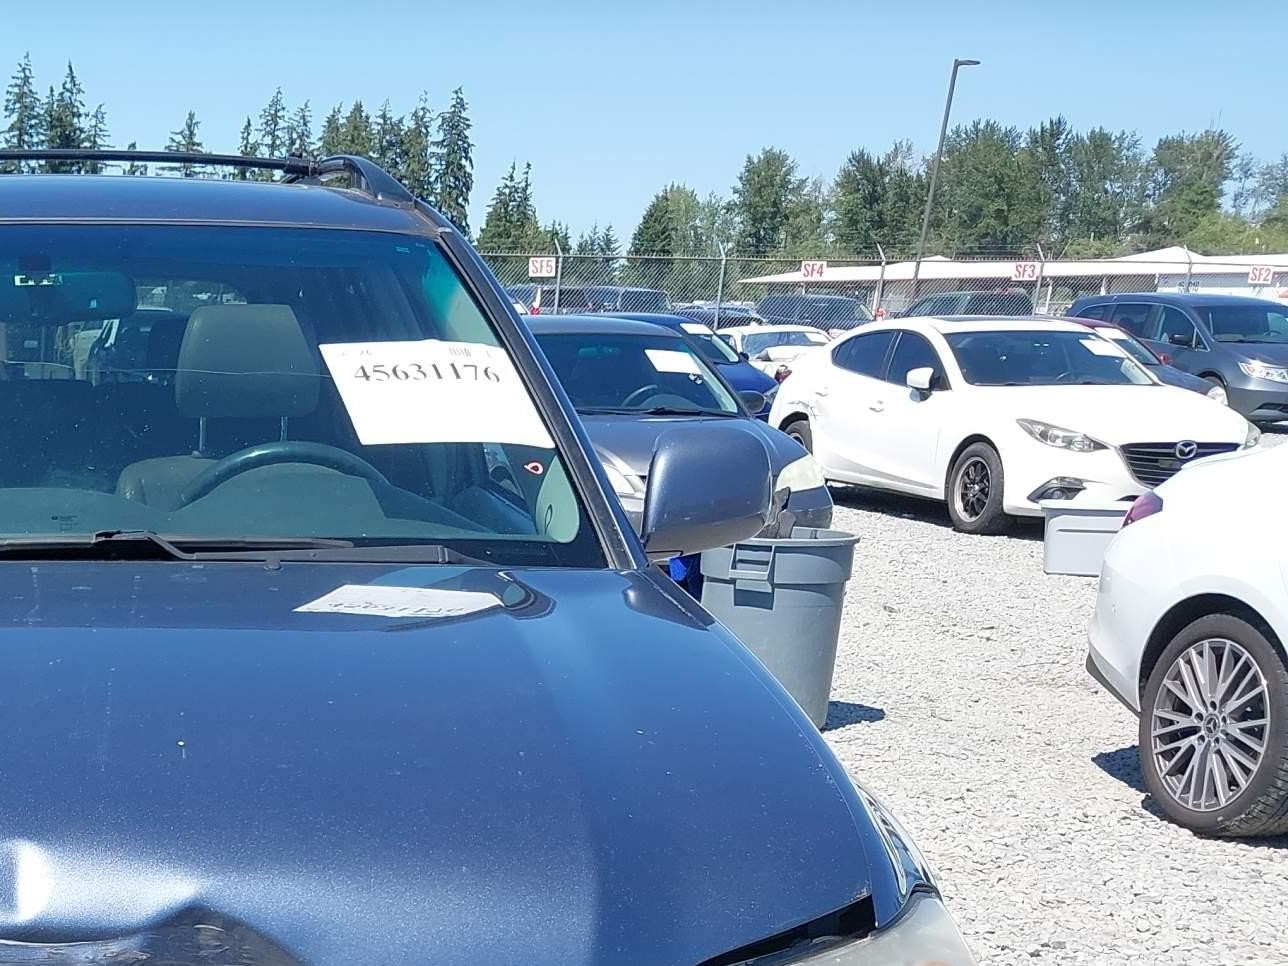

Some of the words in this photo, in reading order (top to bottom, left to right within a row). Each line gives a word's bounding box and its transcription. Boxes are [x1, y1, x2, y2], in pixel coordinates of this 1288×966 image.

[532, 259, 554, 274] SF5
[803, 263, 824, 278] SF4
[1015, 264, 1036, 279] SF3
[1250, 267, 1272, 282] SF2
[354, 362, 500, 383] 45631176
